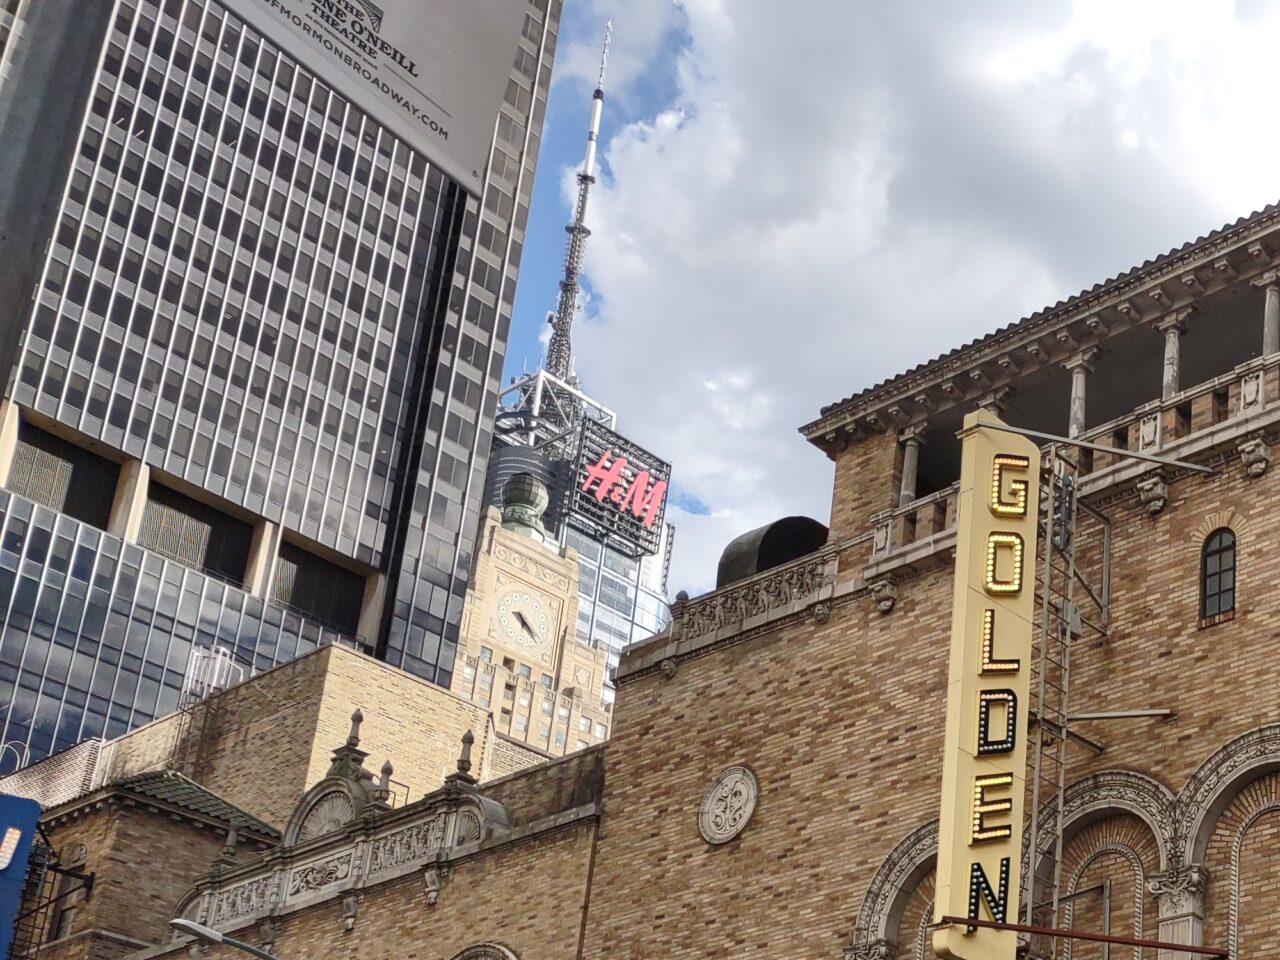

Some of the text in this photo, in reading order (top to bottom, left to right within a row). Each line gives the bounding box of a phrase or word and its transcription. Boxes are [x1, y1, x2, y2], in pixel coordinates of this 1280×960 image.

[310, 2, 378, 60] THEATRE
[350, 20, 420, 78] O'NEILL
[582, 449, 668, 529] H&M
[963, 453, 1030, 936] GOLDEN
